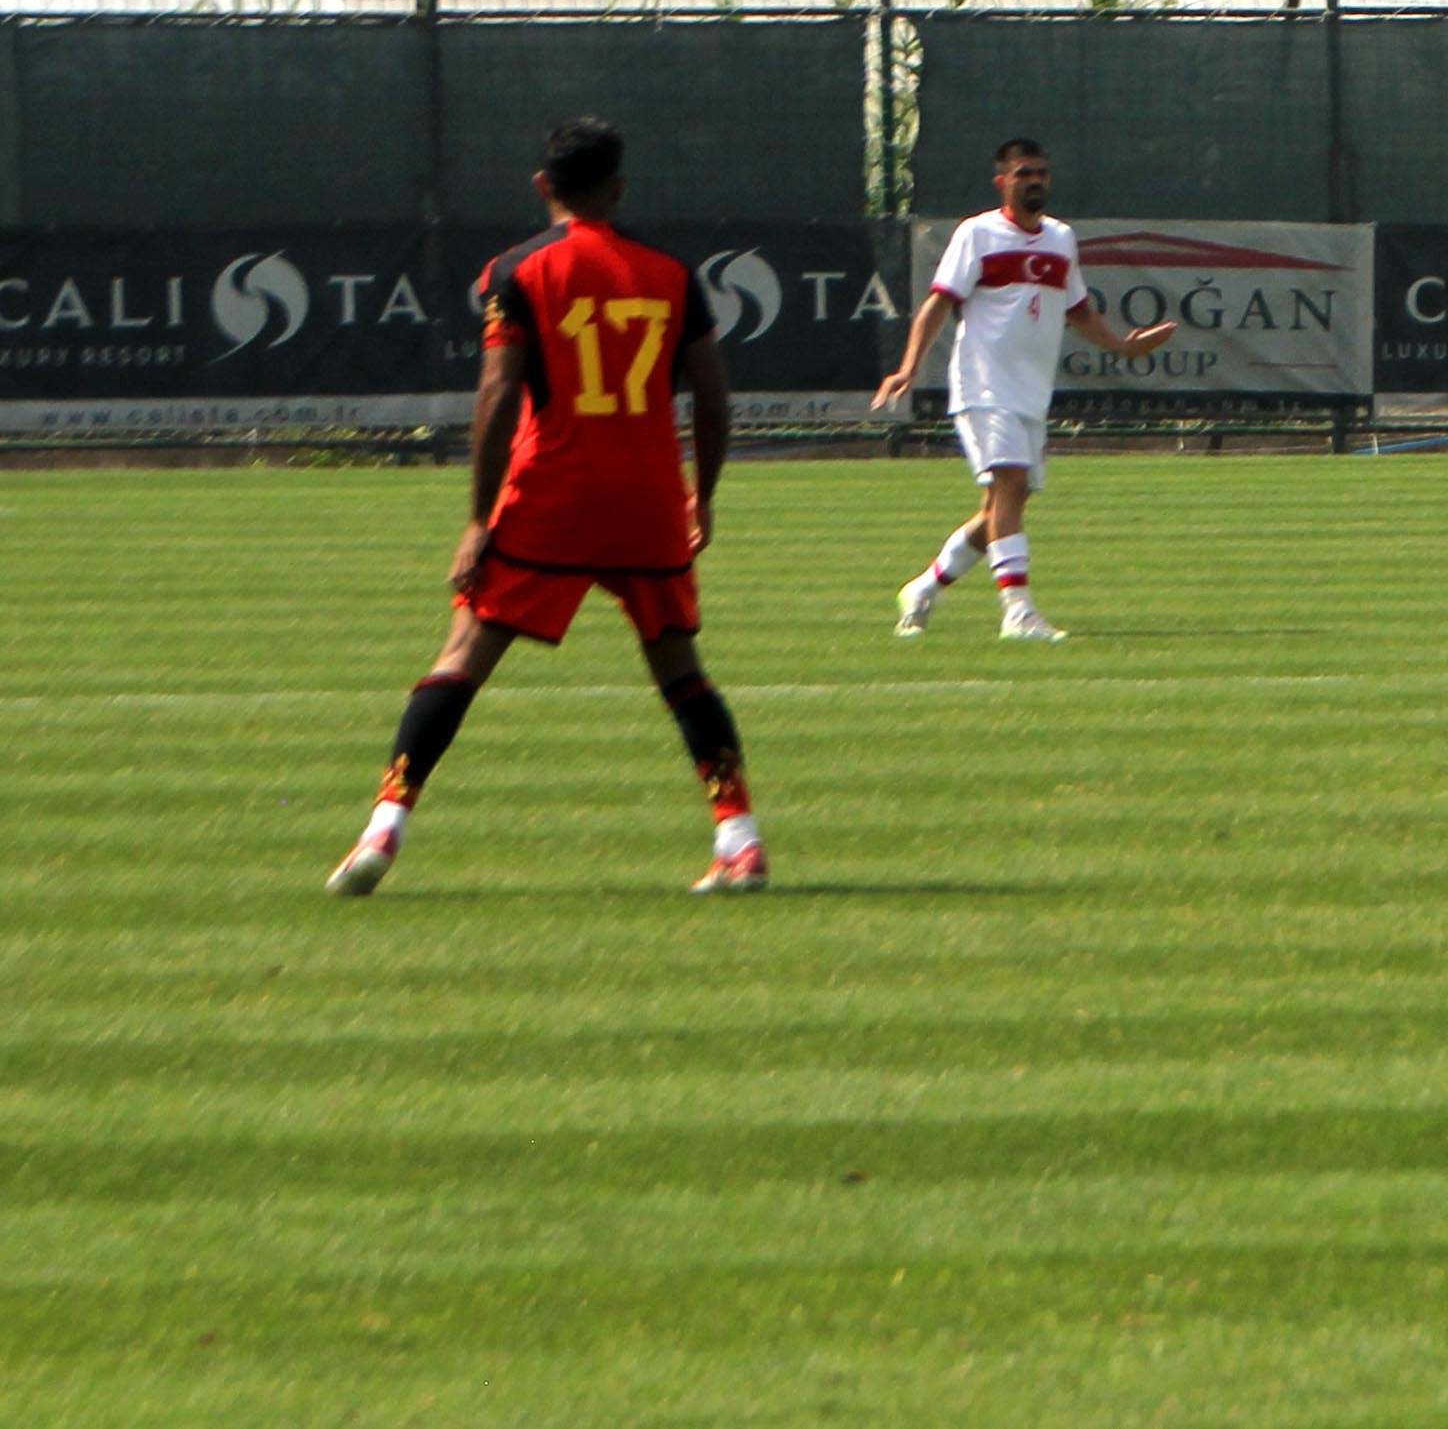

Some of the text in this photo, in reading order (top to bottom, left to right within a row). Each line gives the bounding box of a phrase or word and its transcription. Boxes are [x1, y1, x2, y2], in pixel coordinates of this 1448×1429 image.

[1028, 292, 1042, 322] 4
[1085, 276, 1338, 331] OĞAN
[557, 296, 672, 416] 17
[1062, 349, 1218, 378] GROUP
